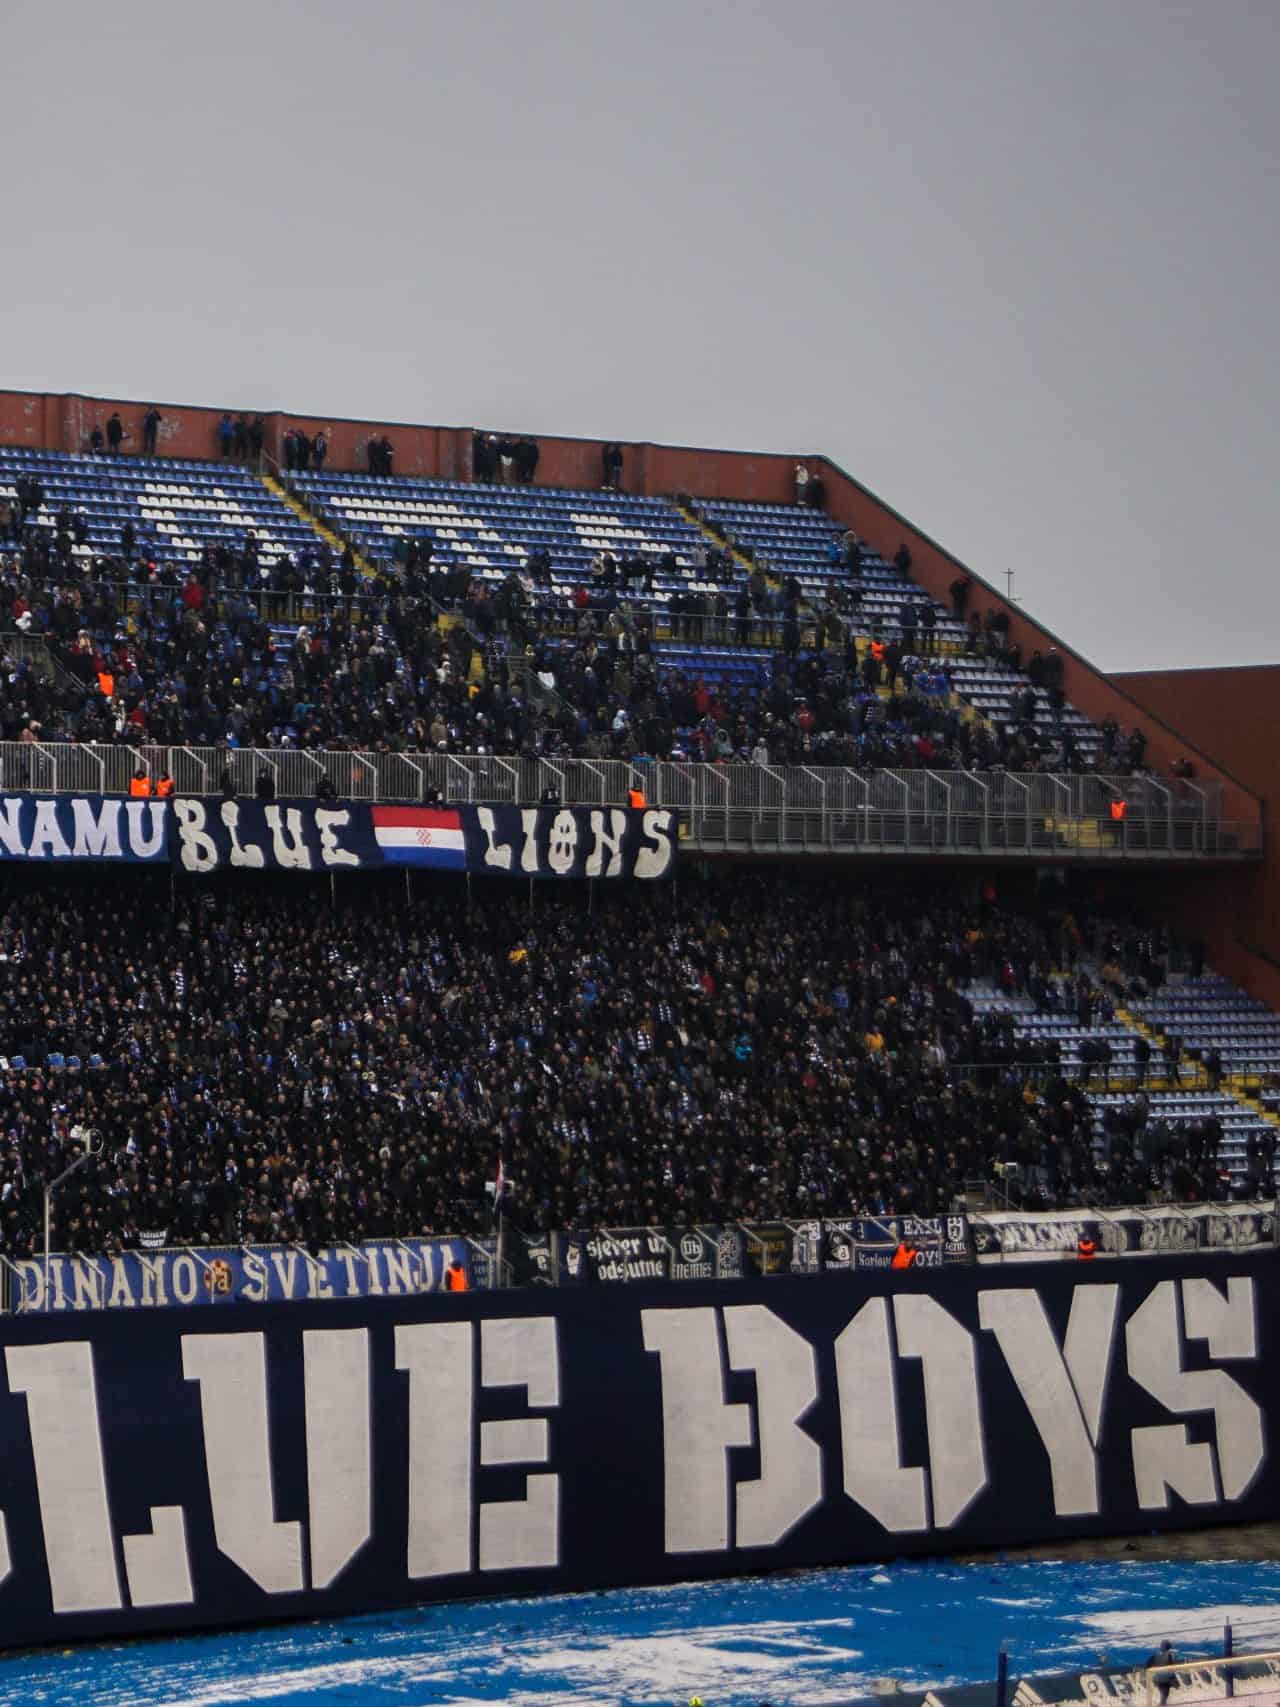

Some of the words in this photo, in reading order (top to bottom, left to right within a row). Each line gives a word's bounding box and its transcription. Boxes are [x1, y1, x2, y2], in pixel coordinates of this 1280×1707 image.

[175, 799, 359, 873] BLUE
[477, 807, 672, 879] LIONS
[15, 1256, 197, 1312] DINAMO
[241, 1244, 454, 1301] SVETINJA
[912, 1250, 942, 1267] OYS
[641, 1277, 1264, 1553] BOYS
